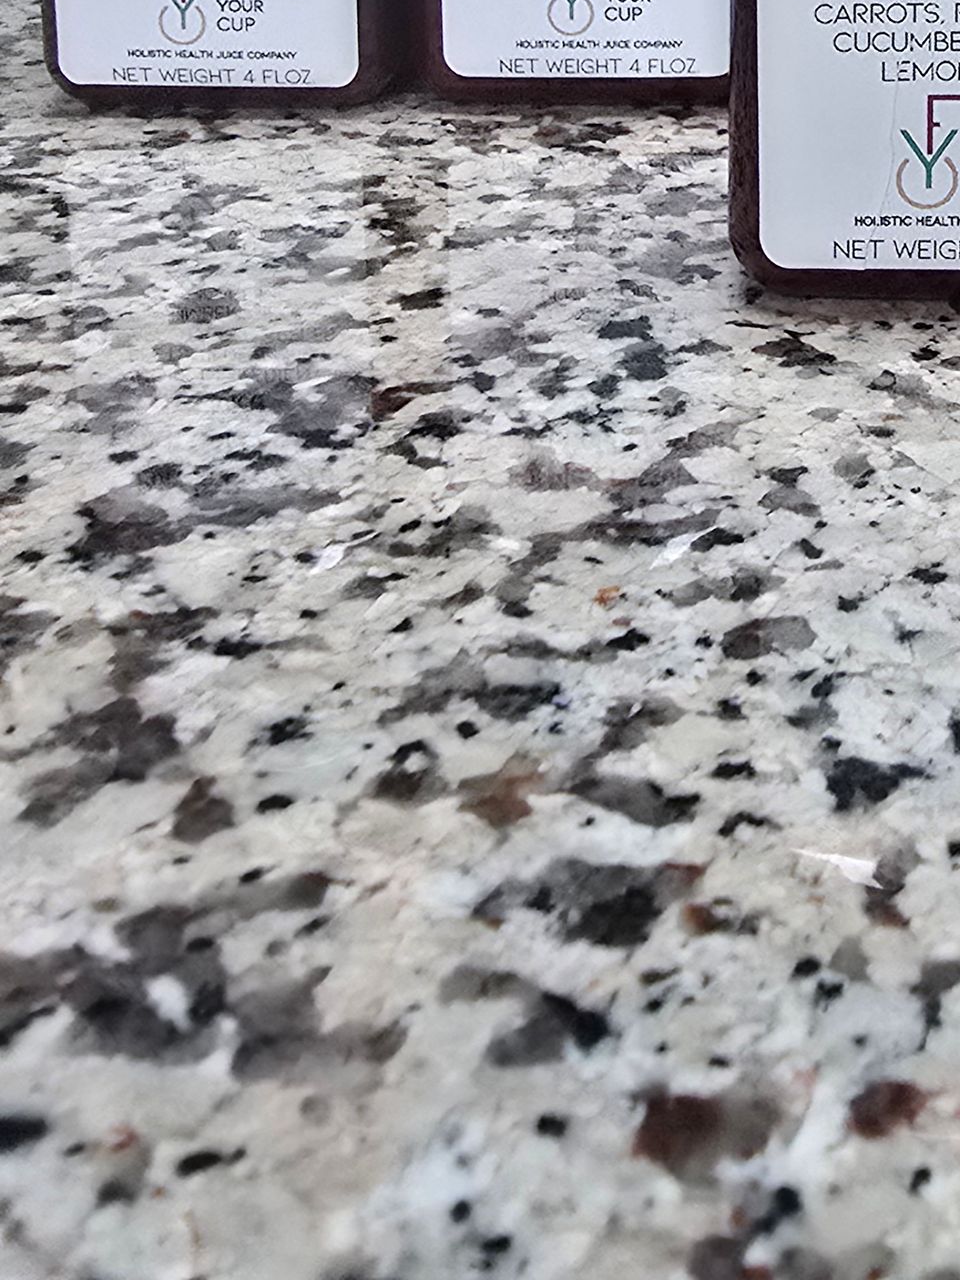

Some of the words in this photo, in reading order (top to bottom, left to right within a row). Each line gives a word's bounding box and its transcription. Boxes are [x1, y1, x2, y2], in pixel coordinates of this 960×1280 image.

[216, 0, 264, 13] YOUR
[604, 6, 642, 22] CUP
[814, 2, 945, 25] CARROTS,
[216, 16, 256, 32] CUP
[500, 58, 539, 74] NET
[546, 58, 622, 74] WEIGHT
[629, 59, 641, 73] 4
[113, 67, 152, 82] NET
[158, 68, 235, 84] WEIGHT
[243, 70, 255, 83] 4
[854, 215, 912, 227] HOLISTIC
[833, 239, 885, 260] NET
